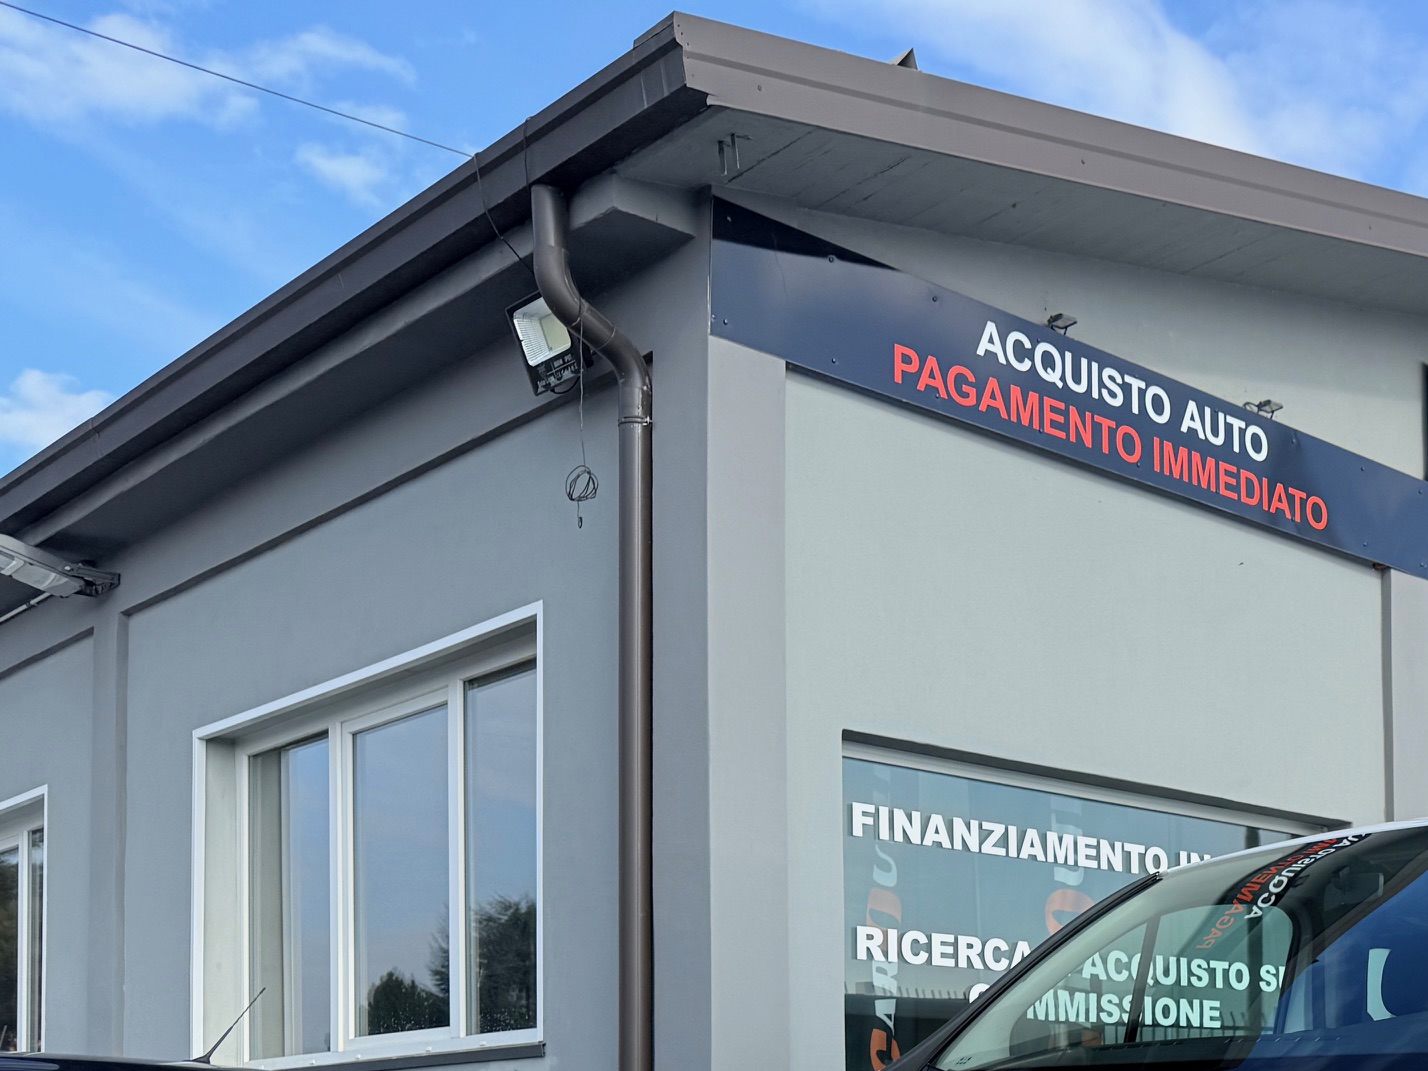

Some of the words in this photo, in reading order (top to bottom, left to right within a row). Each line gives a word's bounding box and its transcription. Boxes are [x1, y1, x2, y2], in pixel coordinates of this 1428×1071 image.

[893, 343, 1142, 463] PAGAMENTO
[1153, 437, 1328, 530] IMMEDIATO
[976, 320, 1171, 424] ACQUISTO
[1181, 400, 1269, 461] AUTO
[852, 802, 1168, 875] FINANZIAMENTO
[969, 983, 1222, 1028] MMISSIONE
